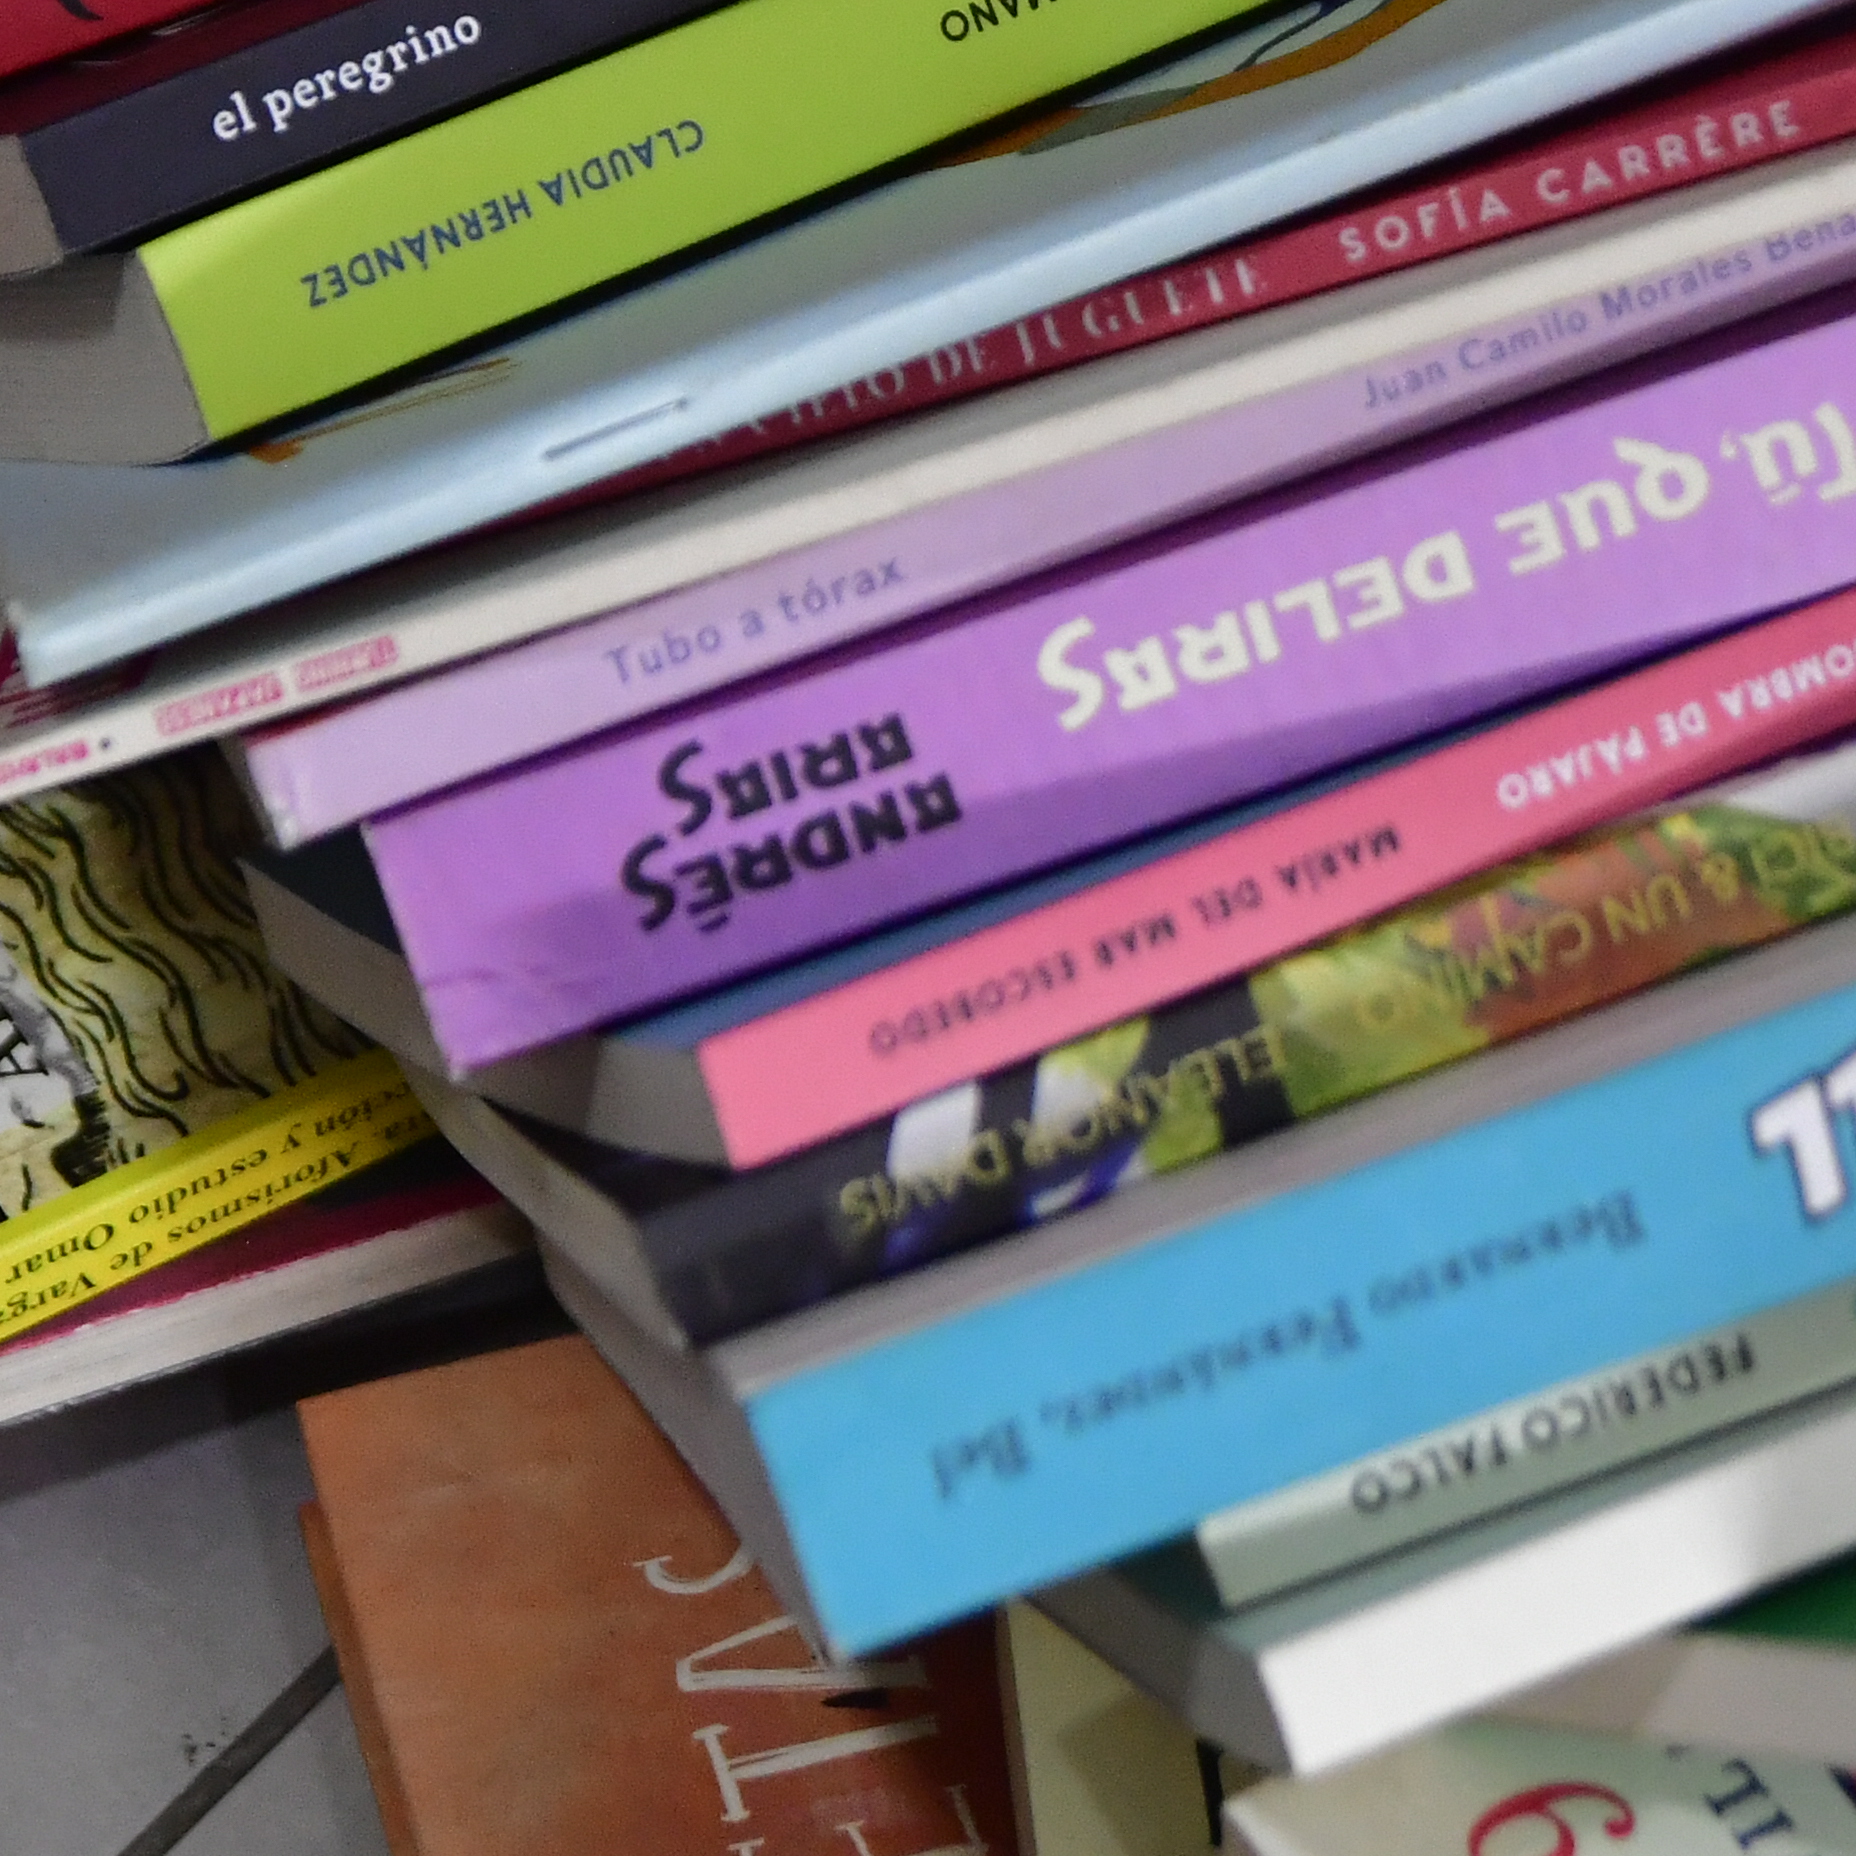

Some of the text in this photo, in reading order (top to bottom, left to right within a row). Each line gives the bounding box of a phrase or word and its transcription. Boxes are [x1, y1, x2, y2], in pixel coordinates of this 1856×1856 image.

[202, 16, 481, 146] el peregrino
[301, 120, 704, 308] CLAUDIA HERNÁNDEZ
[1339, 100, 1798, 263] SOFÍA CARRÈRE
[1353, 349, 1452, 414] Juan
[1451, 311, 1588, 371] Camilo
[1593, 240, 1752, 321] Morales
[1495, 438, 1710, 574] QUE
[604, 559, 904, 683] Tubo a tórax
[1038, 531, 1475, 731] DELIRAS
[659, 715, 913, 837] ARIAS
[1648, 694, 1714, 752] DE
[624, 743, 962, 933] ANDRÉS
[1279, 826, 1400, 889] MARÍA
[1086, 905, 1184, 973] MAR
[1192, 878, 1263, 925] DEL
[130, 1150, 270, 1225] estudio
[164, 1150, 357, 1248] Aforismos
[276, 1130, 312, 1159] y
[0, 1221, 116, 1292] Omar
[107, 1242, 148, 1281] de
[1351, 1333, 1757, 1525] FEDERICO FALCO
